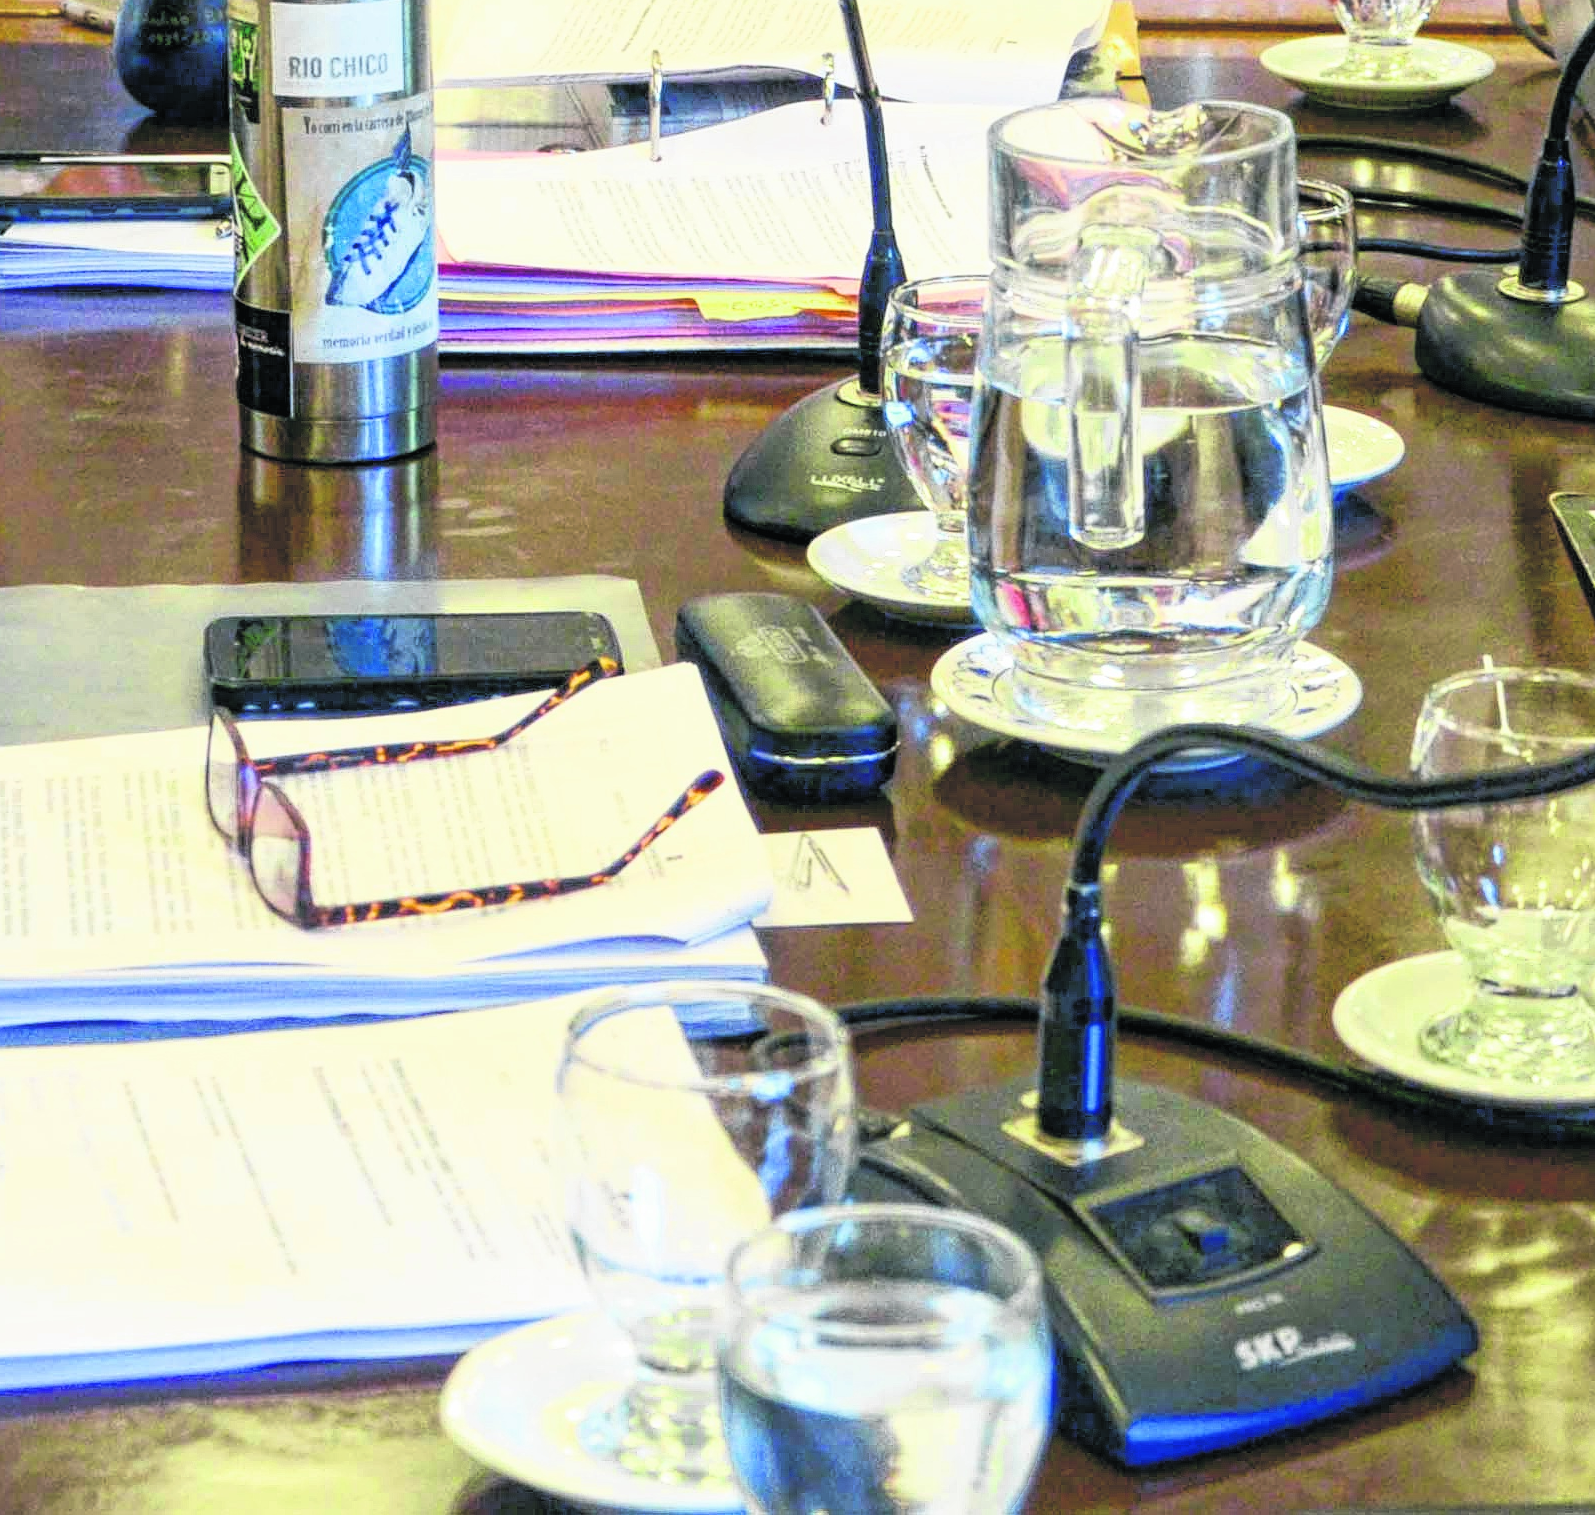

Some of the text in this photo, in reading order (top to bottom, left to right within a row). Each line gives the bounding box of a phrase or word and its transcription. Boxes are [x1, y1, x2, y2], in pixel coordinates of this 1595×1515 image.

[288, 52, 388, 78] RIO CHICO
[1234, 1326, 1301, 1371] SKP
